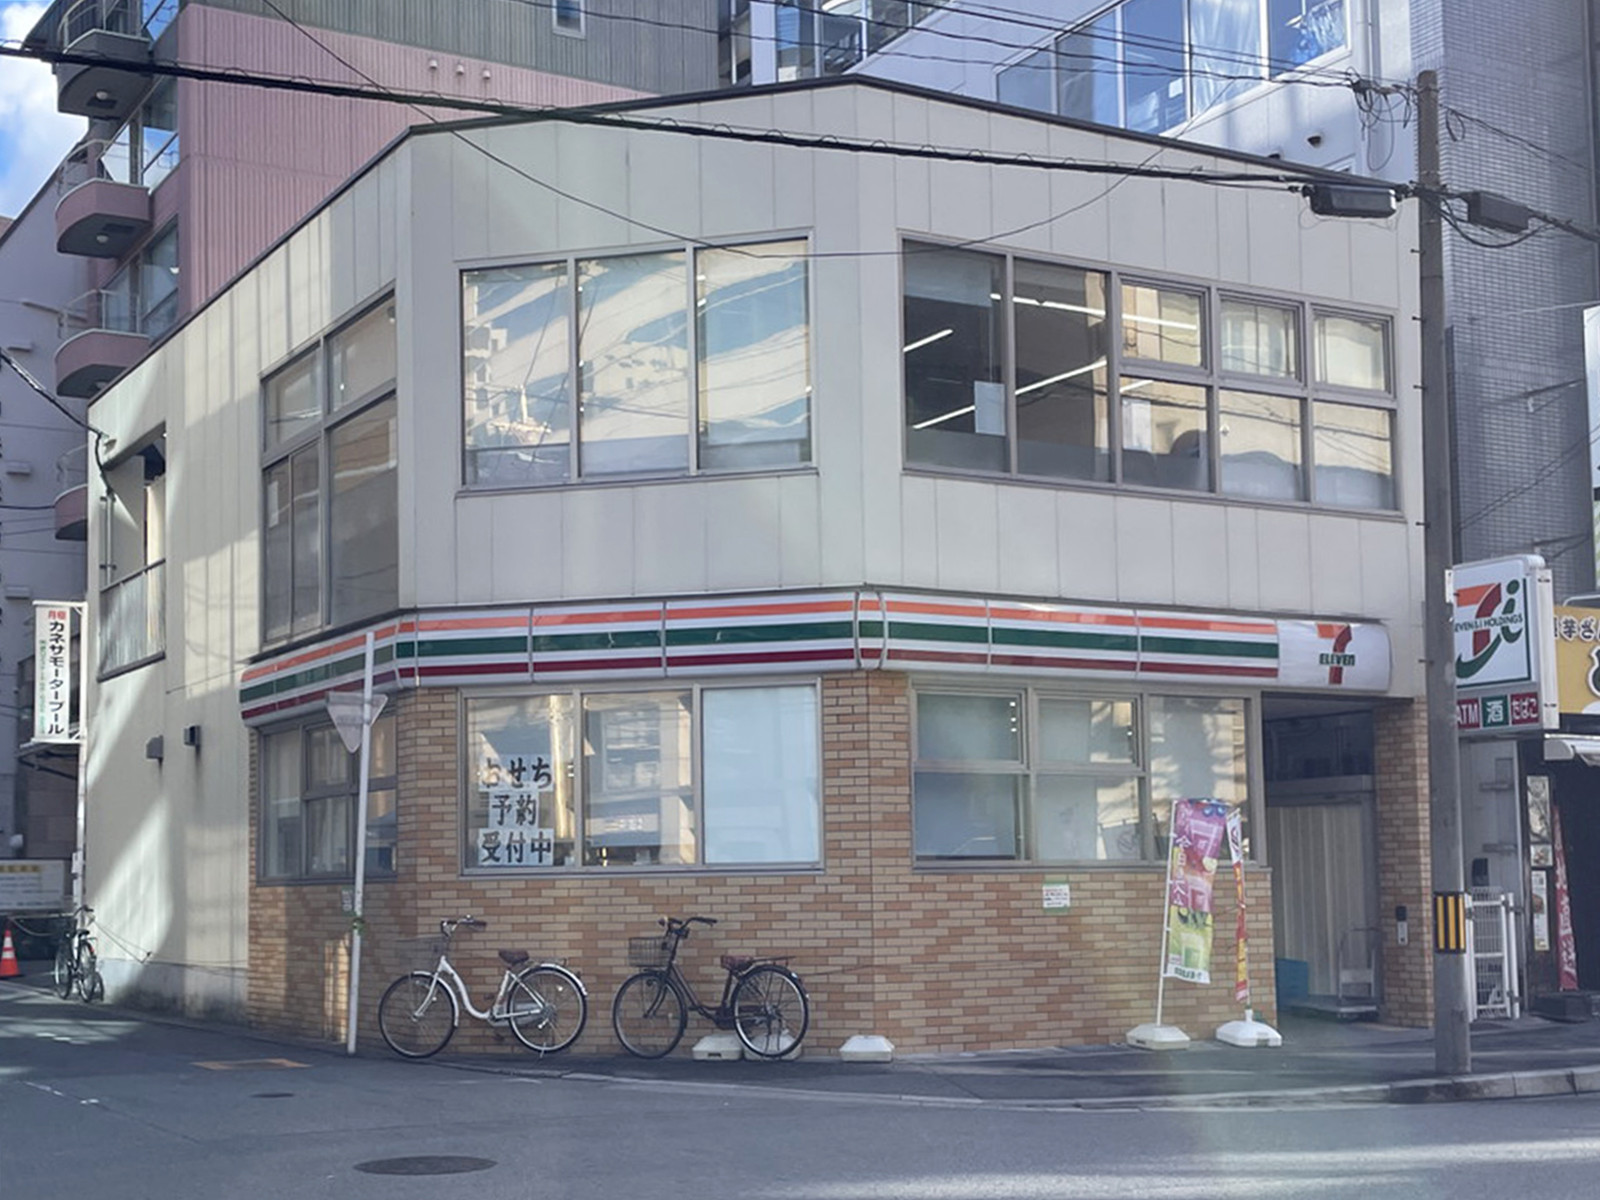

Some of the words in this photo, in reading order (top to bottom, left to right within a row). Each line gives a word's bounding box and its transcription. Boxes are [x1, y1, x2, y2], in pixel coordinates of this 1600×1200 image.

[1484, 613, 1523, 629] HOLDINGS
[1486, 701, 1504, 724] 酒
[1511, 696, 1539, 721] たばこ
[481, 757, 552, 788] おせち
[491, 794, 538, 826] 予約
[481, 831, 551, 863] 受付中
